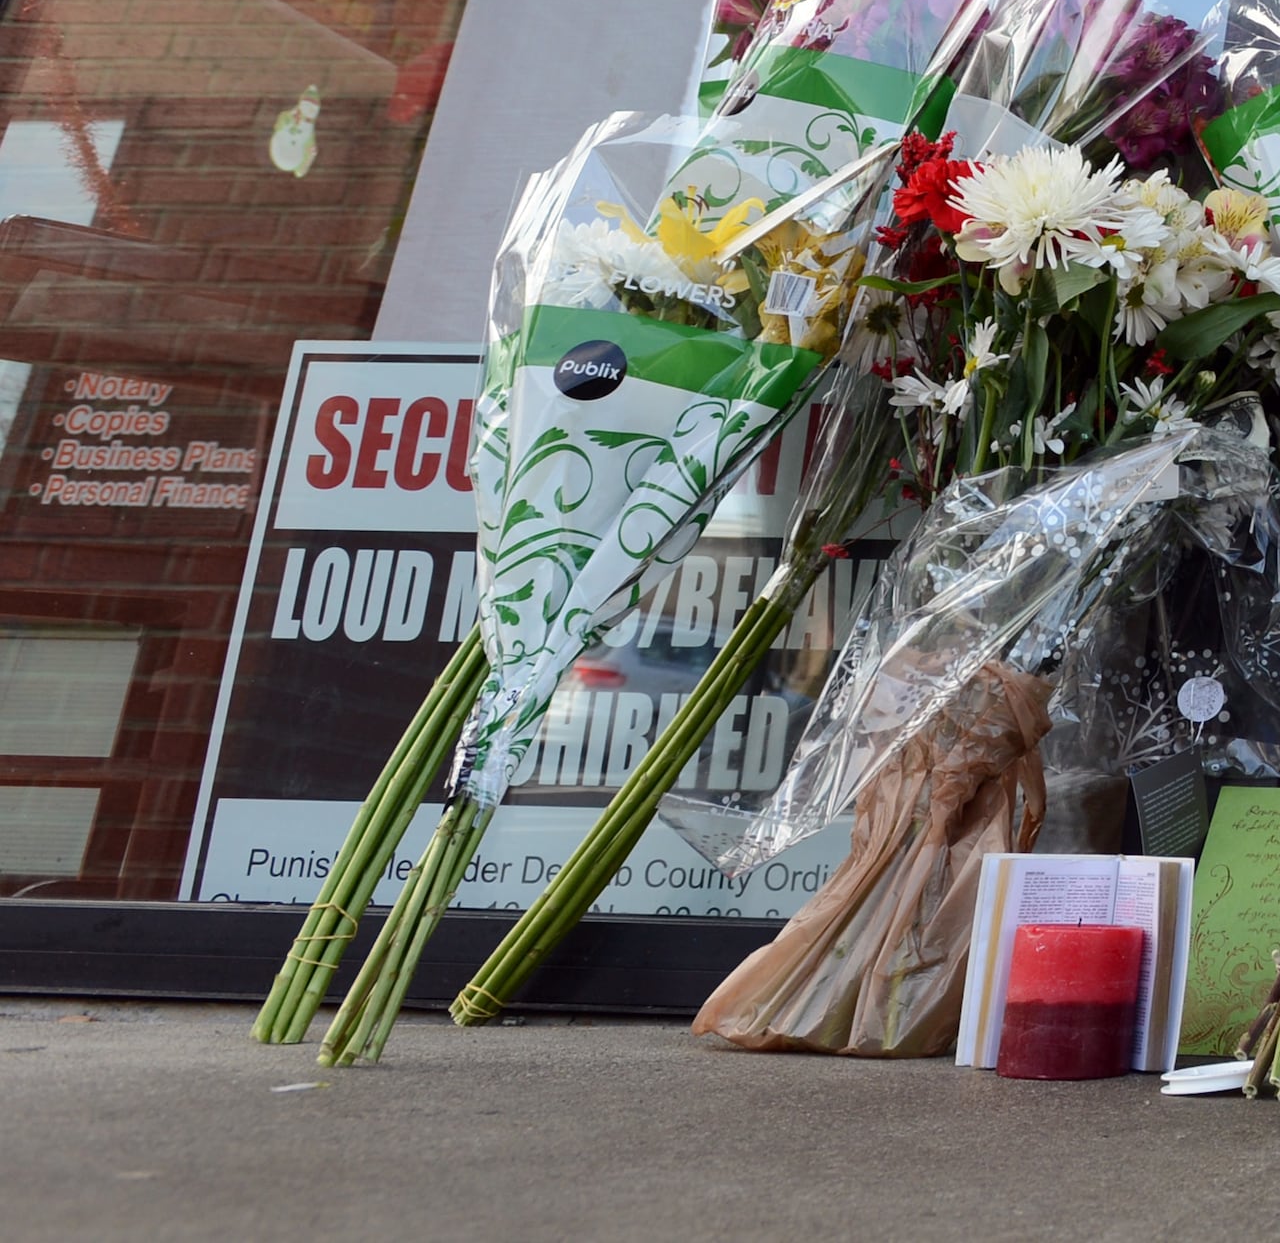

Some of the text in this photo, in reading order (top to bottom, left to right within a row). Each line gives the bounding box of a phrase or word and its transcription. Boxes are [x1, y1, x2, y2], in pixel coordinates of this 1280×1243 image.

[608, 269, 737, 309] FLOWERS
[559, 358, 621, 381] Publix
[74, 372, 173, 406] Notary
[65, 404, 170, 440] Copies
[52, 439, 182, 470] Business
[41, 475, 155, 505] Personal
[270, 546, 434, 643] LOUD
[247, 848, 409, 880] Punisle
[644, 856, 753, 898] County
